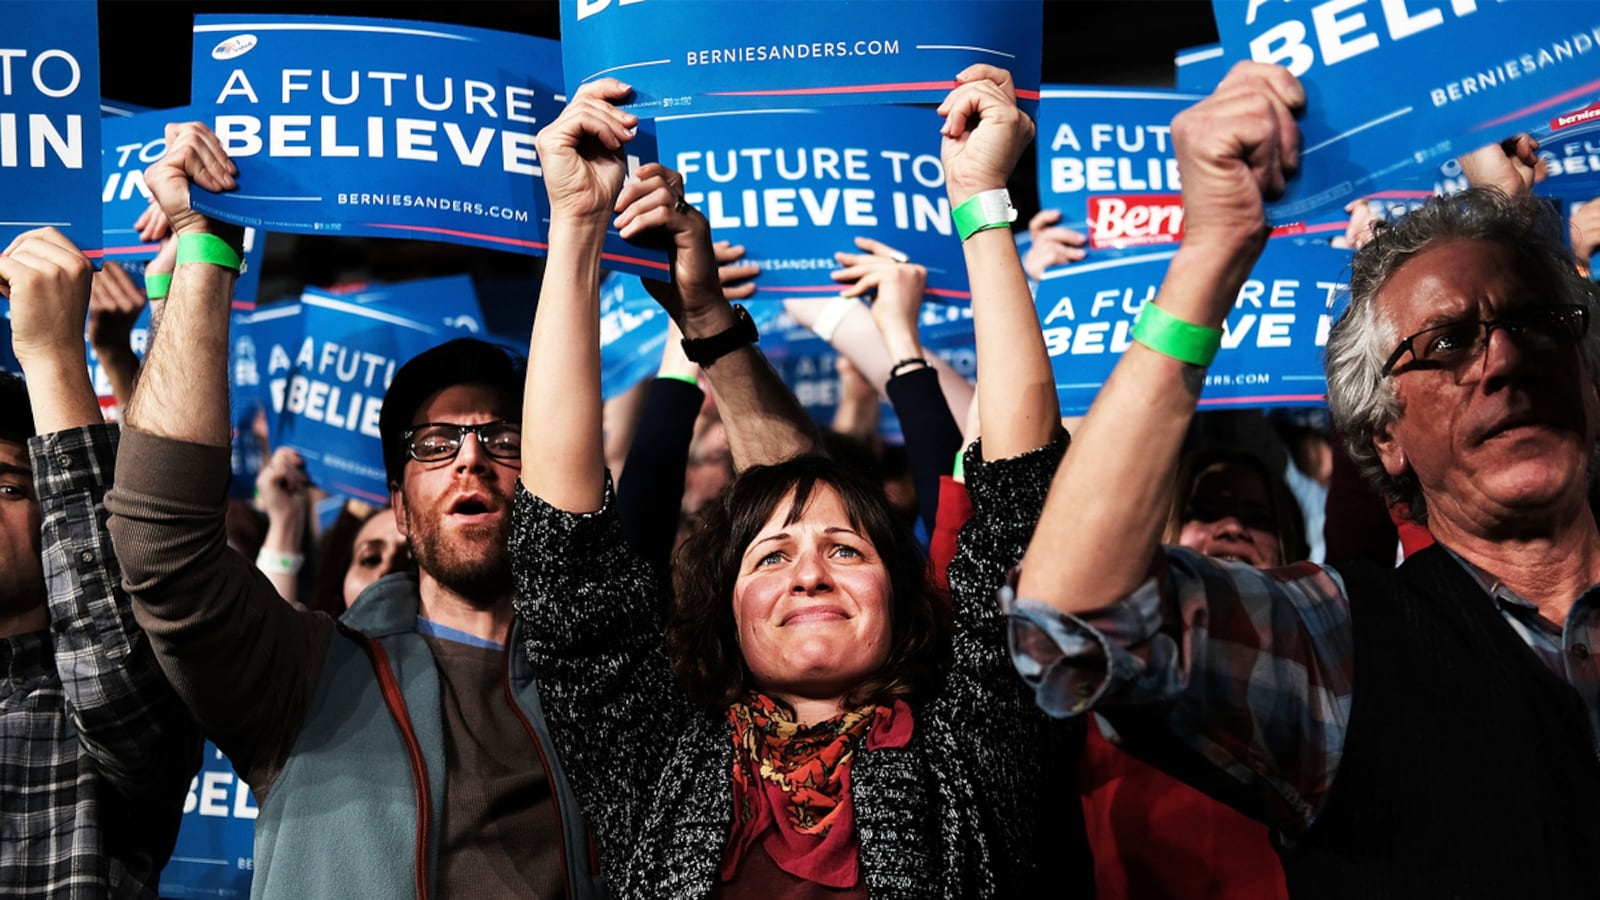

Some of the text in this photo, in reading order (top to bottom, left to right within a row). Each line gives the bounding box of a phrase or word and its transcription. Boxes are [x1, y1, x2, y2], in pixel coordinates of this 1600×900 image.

[686, 40, 900, 66] BERNIESANDERS.COM
[0, 48, 81, 98] TO
[216, 69, 536, 123] A FUTURE
[0, 112, 83, 169] IN
[116, 138, 168, 168] TO
[215, 115, 542, 177] BELIEVE
[1051, 123, 1081, 151] A
[677, 147, 871, 184] FUTURE
[881, 150, 945, 188] TO
[337, 193, 529, 222] BERNIESANDERS.COM
[893, 191, 952, 236] IN
[1044, 296, 1075, 325] A
[296, 336, 315, 371] A
